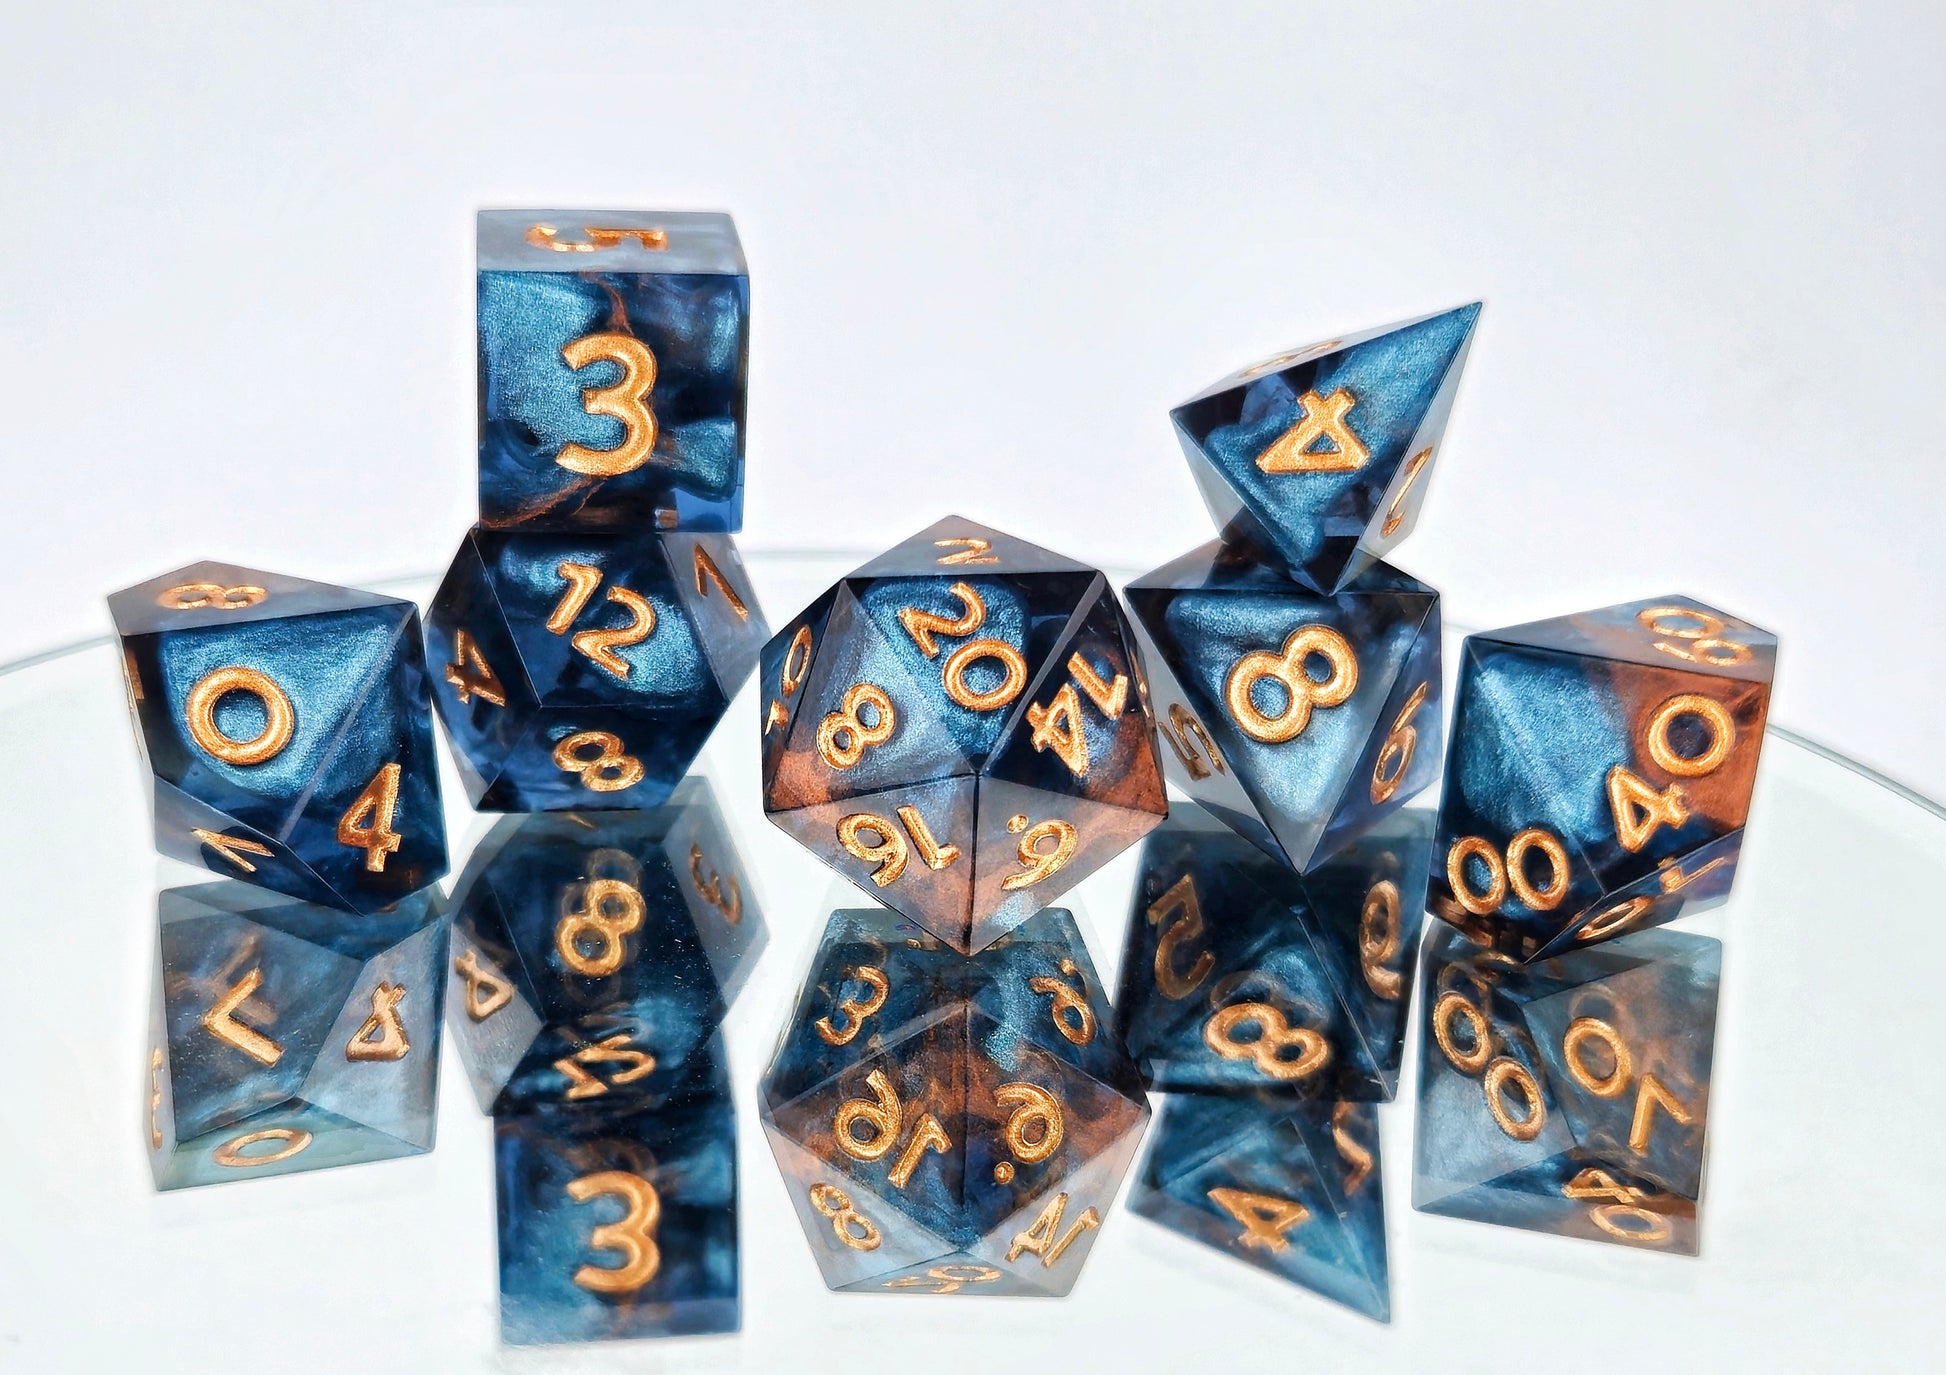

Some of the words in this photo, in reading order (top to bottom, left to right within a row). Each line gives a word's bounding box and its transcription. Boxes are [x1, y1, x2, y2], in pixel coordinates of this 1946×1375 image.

[526, 225, 669, 251] 5
[555, 331, 659, 477] 3
[1255, 386, 1370, 474] 4
[157, 582, 269, 610] 8
[934, 537, 999, 565] 2
[445, 628, 506, 706] 4
[545, 561, 656, 680] 12
[896, 580, 1028, 713] 20
[186, 665, 294, 766] 0
[815, 682, 897, 770] 8
[1025, 649, 1129, 778] 14
[1225, 624, 1359, 743] 8
[552, 730, 646, 793] 8
[1370, 680, 1428, 804] 6
[1605, 684, 1737, 854] 40
[336, 762, 402, 873] 4
[1446, 828, 1570, 916] 00
